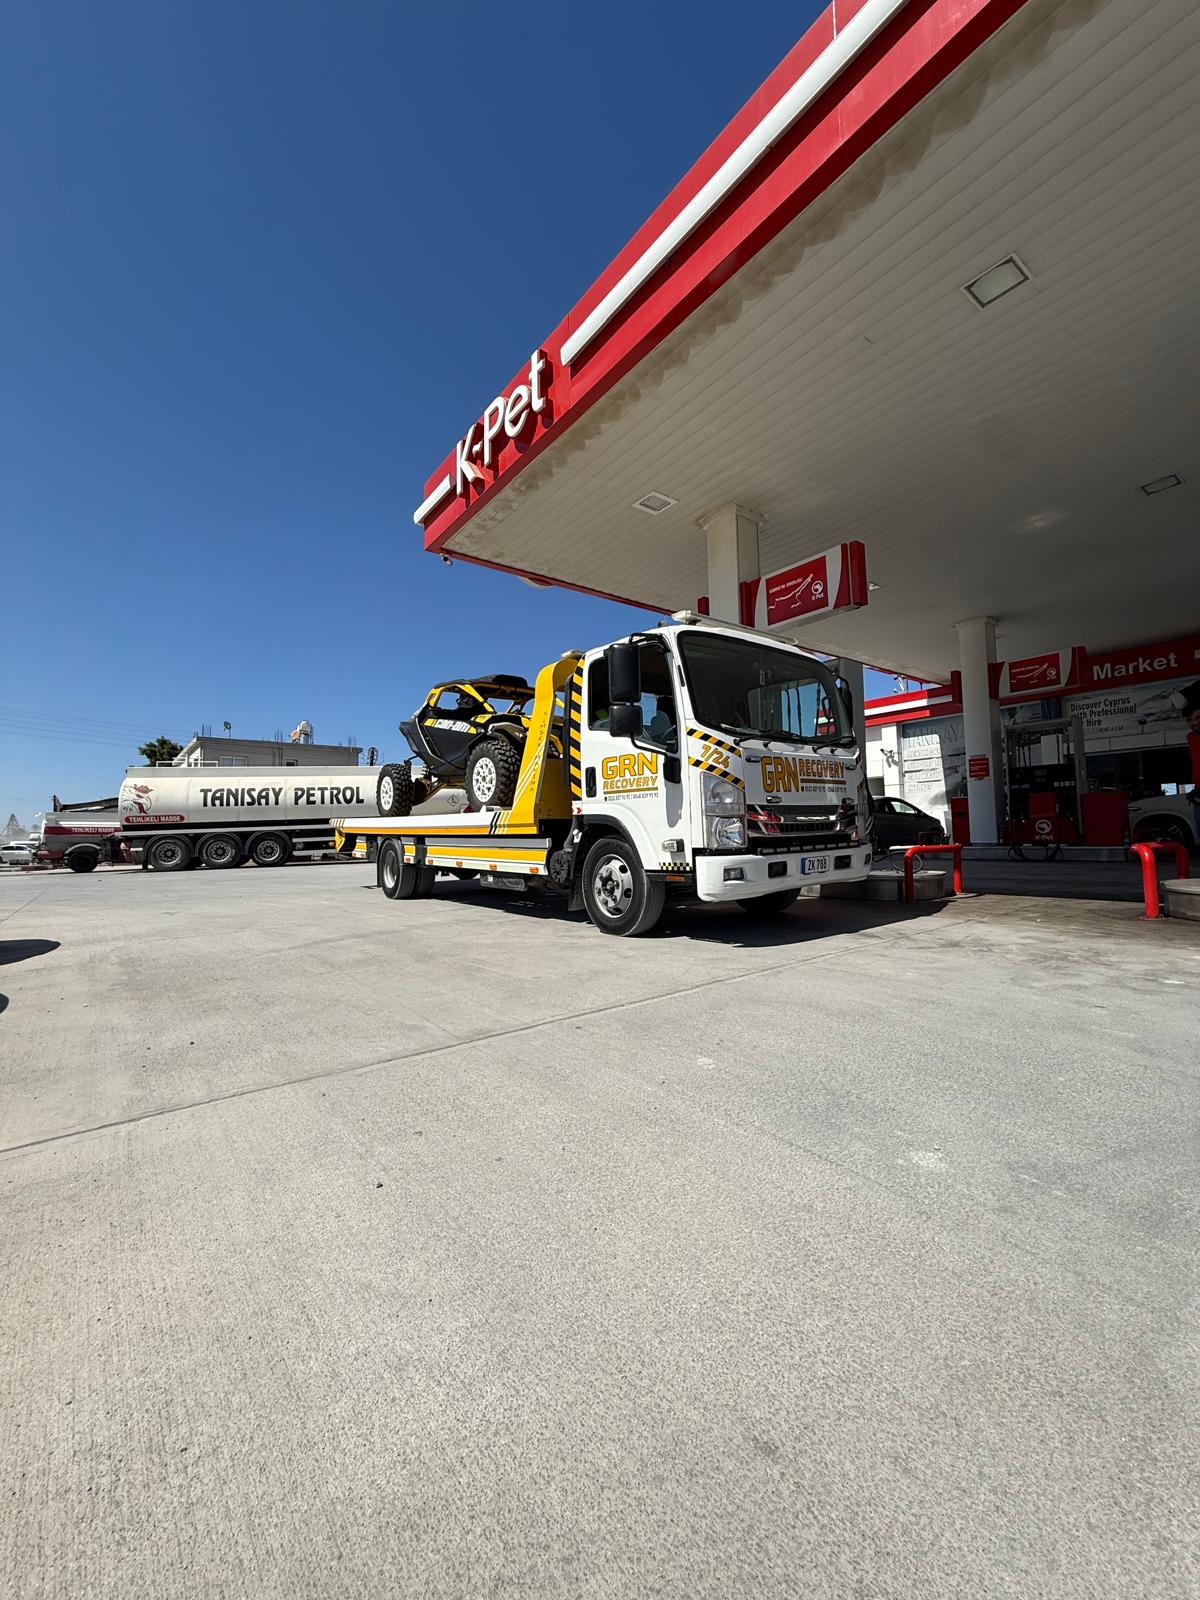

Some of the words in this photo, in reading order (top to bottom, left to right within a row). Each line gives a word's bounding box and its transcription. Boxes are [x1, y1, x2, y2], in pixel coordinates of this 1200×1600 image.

[456, 349, 546, 497] K-Pet
[1092, 651, 1179, 681] Market
[1070, 700, 1102, 712] Discover
[1103, 697, 1131, 708] Cyprus
[1089, 703, 1137, 718] Professional
[1086, 718, 1102, 727] Hire
[601, 752, 658, 780] GRN
[700, 742, 731, 769] 7/24
[760, 755, 799, 793] GRN
[799, 758, 845, 779] RECOVERY
[603, 776, 658, 791] RECOVERY
[199, 787, 284, 808] TANISAY
[293, 785, 365, 806] PETROL
[160, 815, 181, 823] MADDE
[808, 859, 816, 871] ZK
